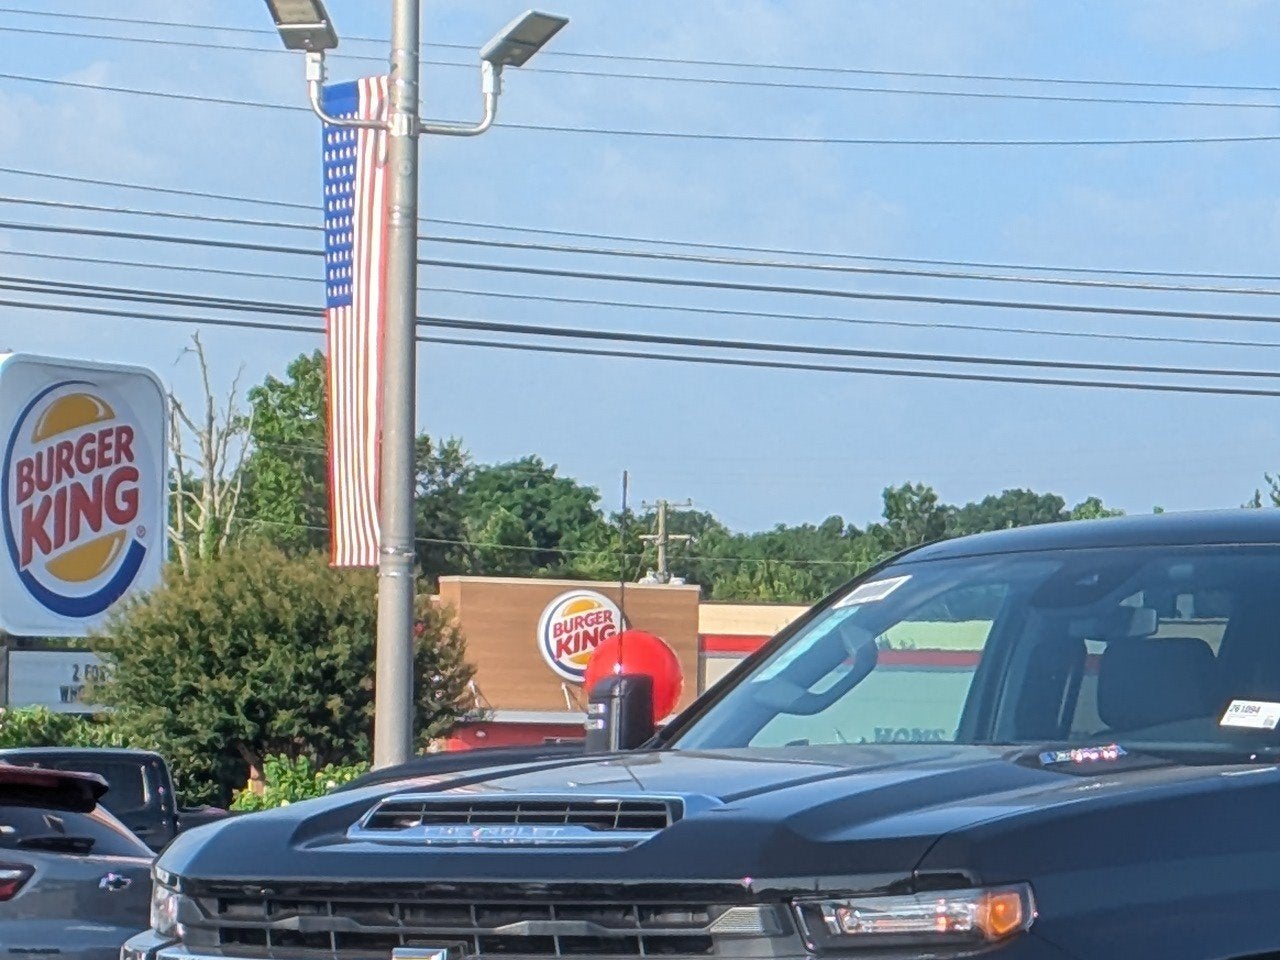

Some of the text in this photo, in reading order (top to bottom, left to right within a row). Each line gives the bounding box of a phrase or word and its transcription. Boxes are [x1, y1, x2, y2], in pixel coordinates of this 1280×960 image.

[16, 425, 135, 505] BURGER
[20, 466, 140, 568] KING
[553, 609, 613, 638] BURGER
[555, 623, 616, 659] KING
